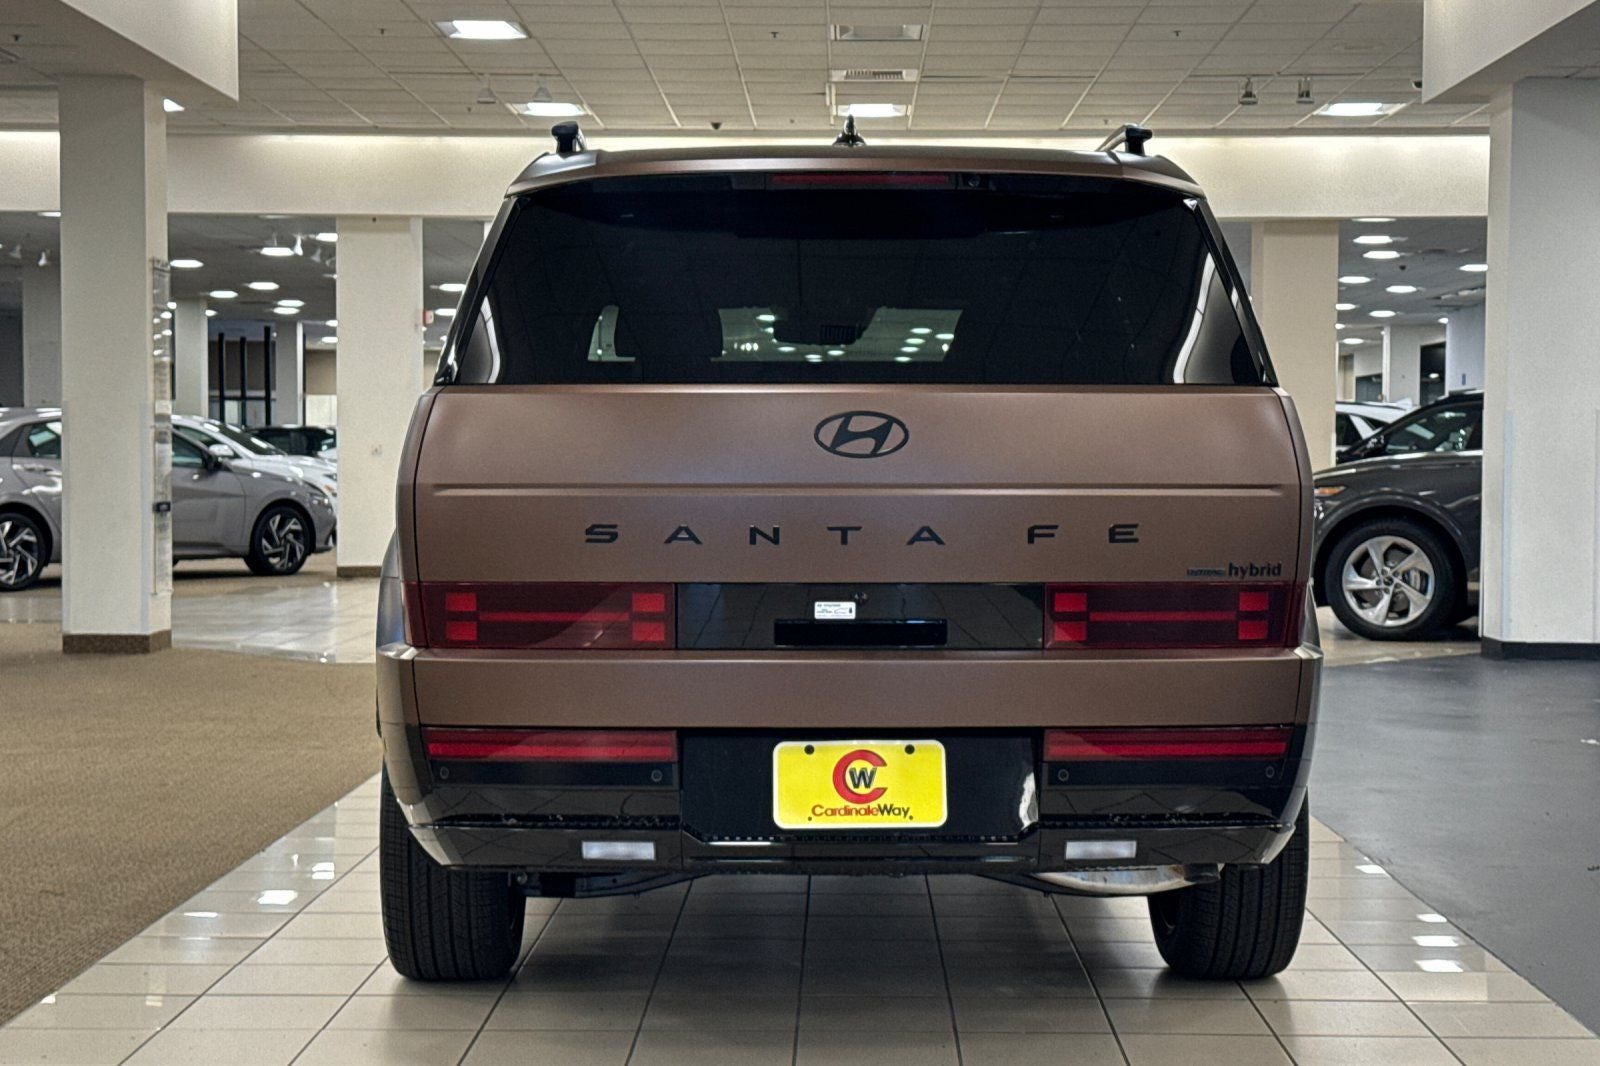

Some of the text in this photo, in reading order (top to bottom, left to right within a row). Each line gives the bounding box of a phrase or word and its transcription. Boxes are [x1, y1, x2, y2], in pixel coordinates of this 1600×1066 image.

[584, 523, 1140, 546] SANTA FE
[1228, 562, 1282, 579] hybrid
